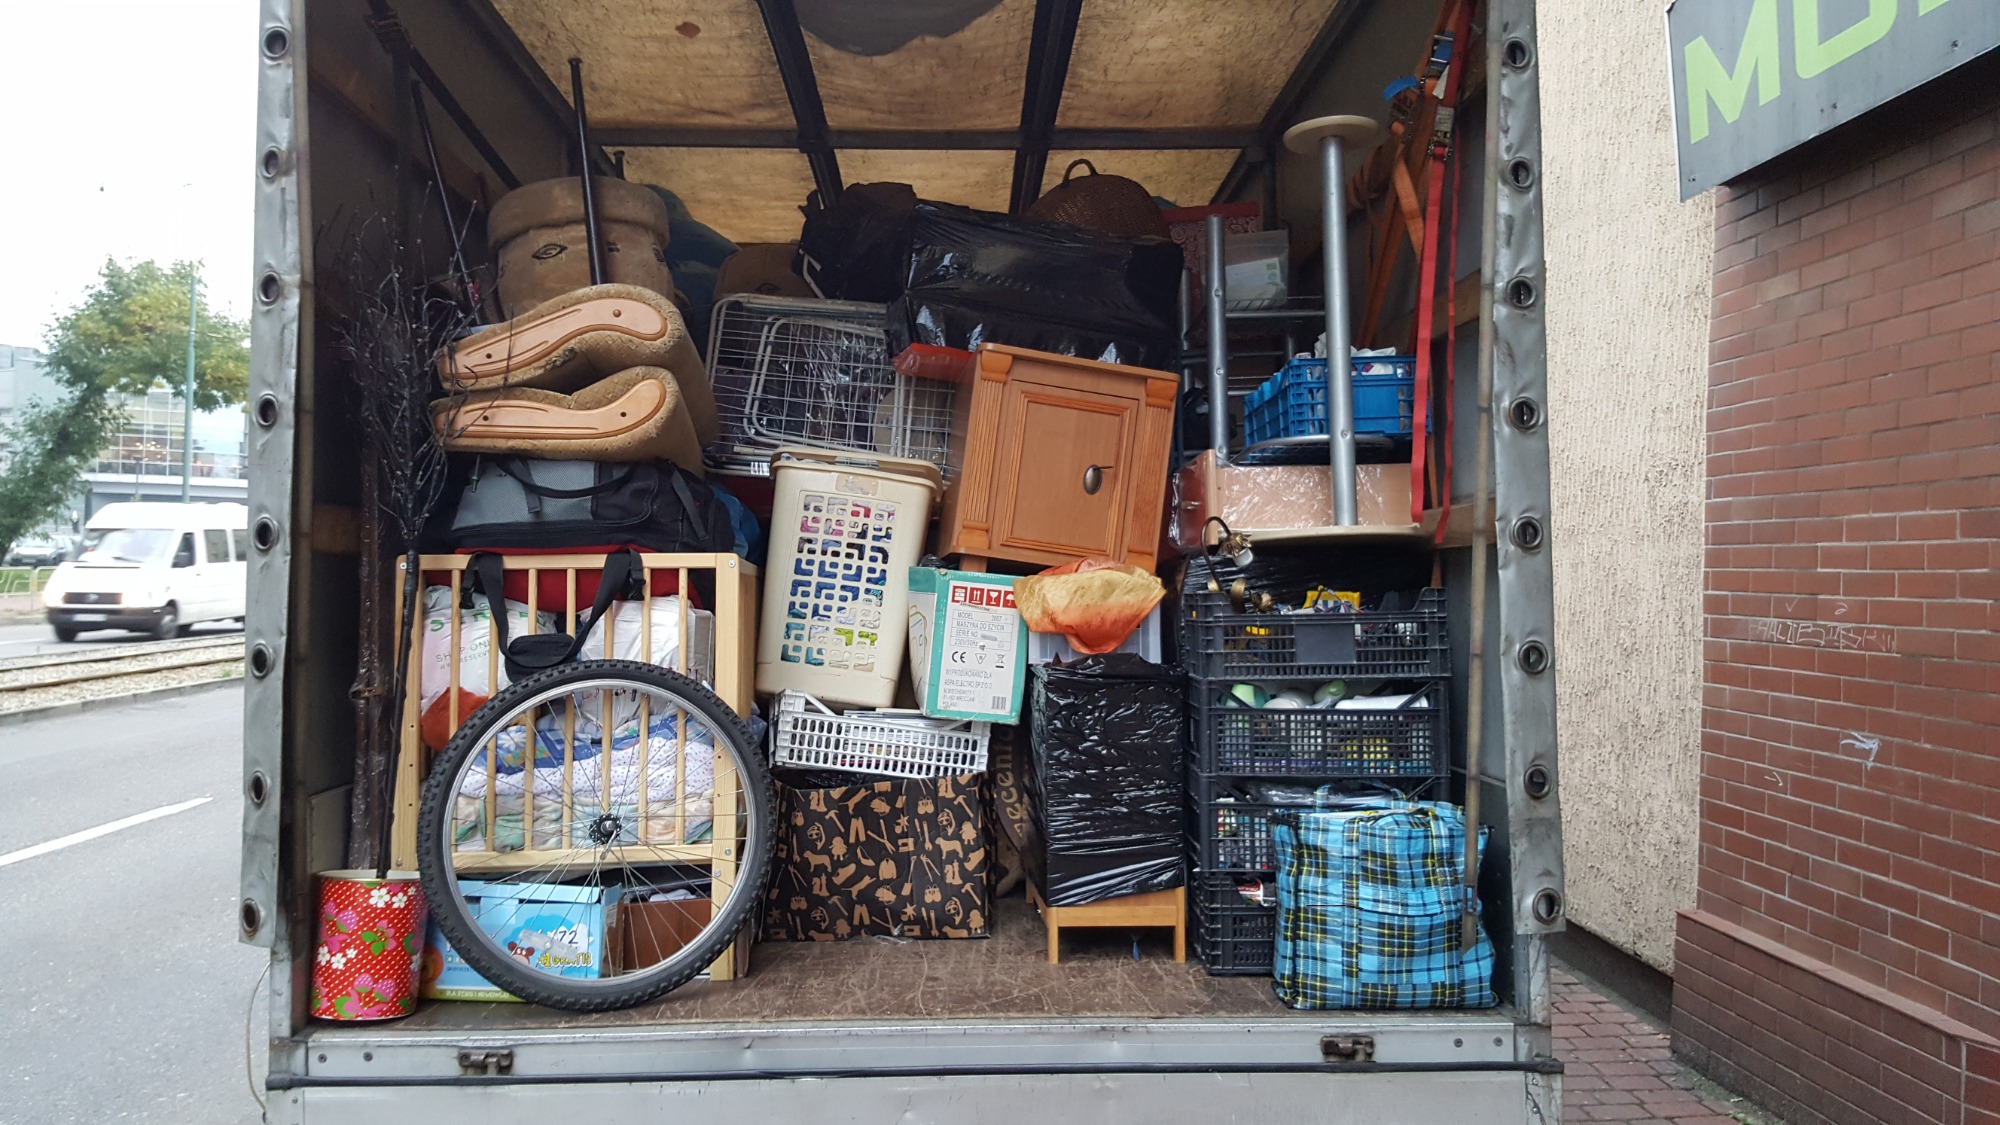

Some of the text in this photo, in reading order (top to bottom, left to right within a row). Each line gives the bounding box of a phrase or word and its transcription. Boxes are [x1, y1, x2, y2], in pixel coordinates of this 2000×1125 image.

[956, 620, 979, 628] MASZYNA
[436, 646, 465, 662] SHP
[952, 651, 966, 663] CE
[558, 930, 578, 944] 72
